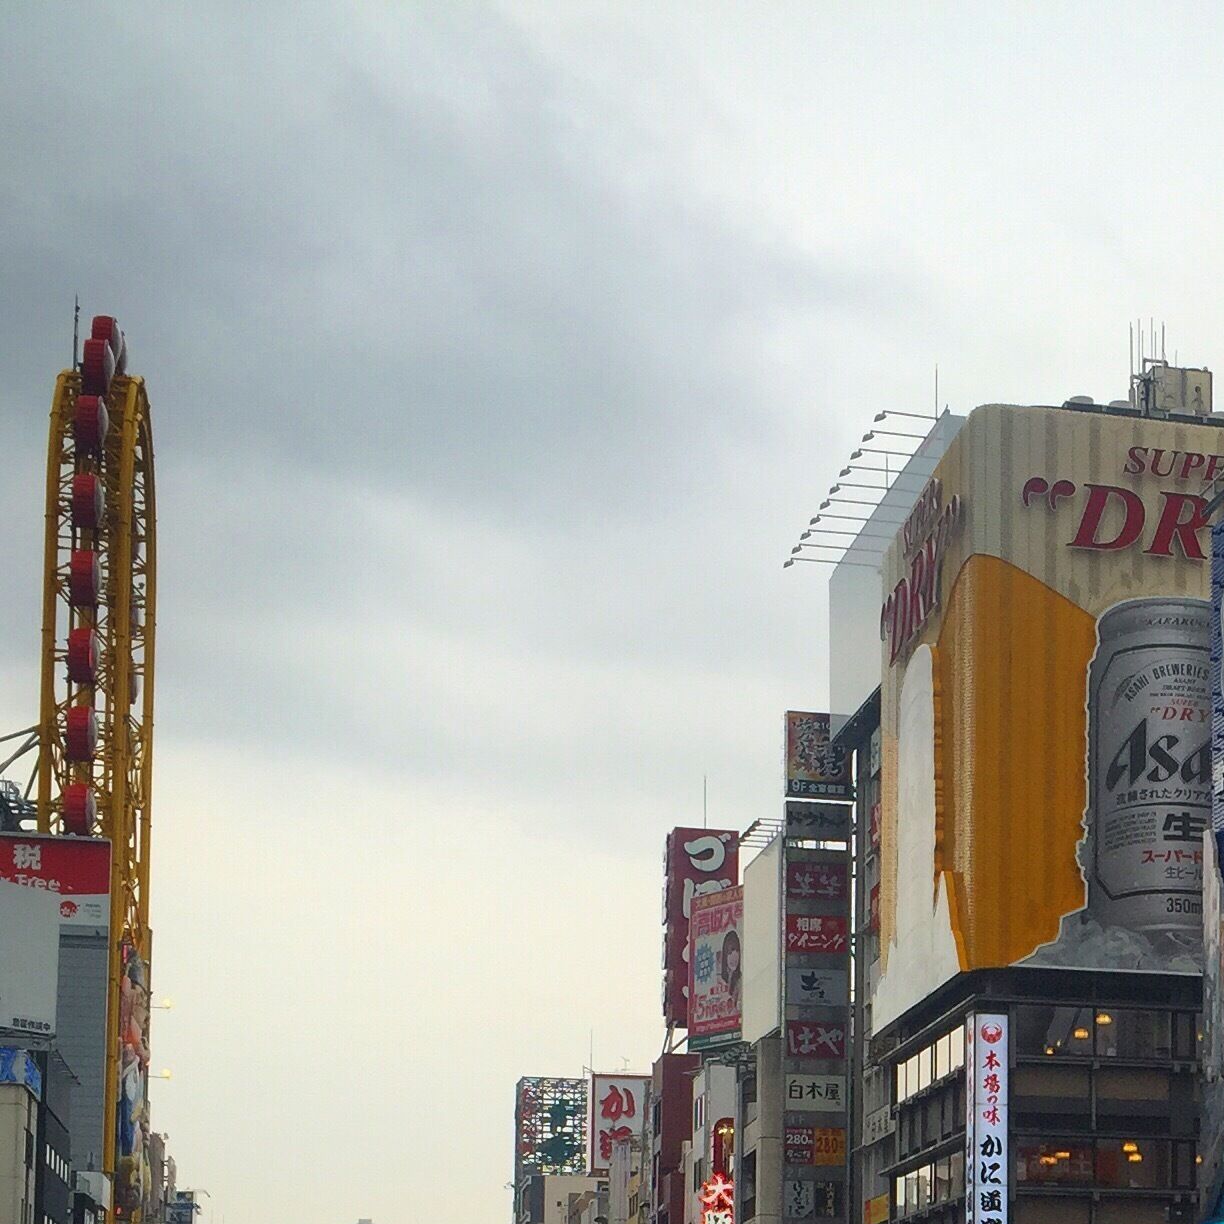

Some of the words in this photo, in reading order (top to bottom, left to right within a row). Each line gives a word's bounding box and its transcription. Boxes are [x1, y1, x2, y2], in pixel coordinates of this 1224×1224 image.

[1162, 811, 1207, 843] 生
[788, 1078, 842, 1102] 白木屋
[982, 1050, 1002, 1127] 本場の味
